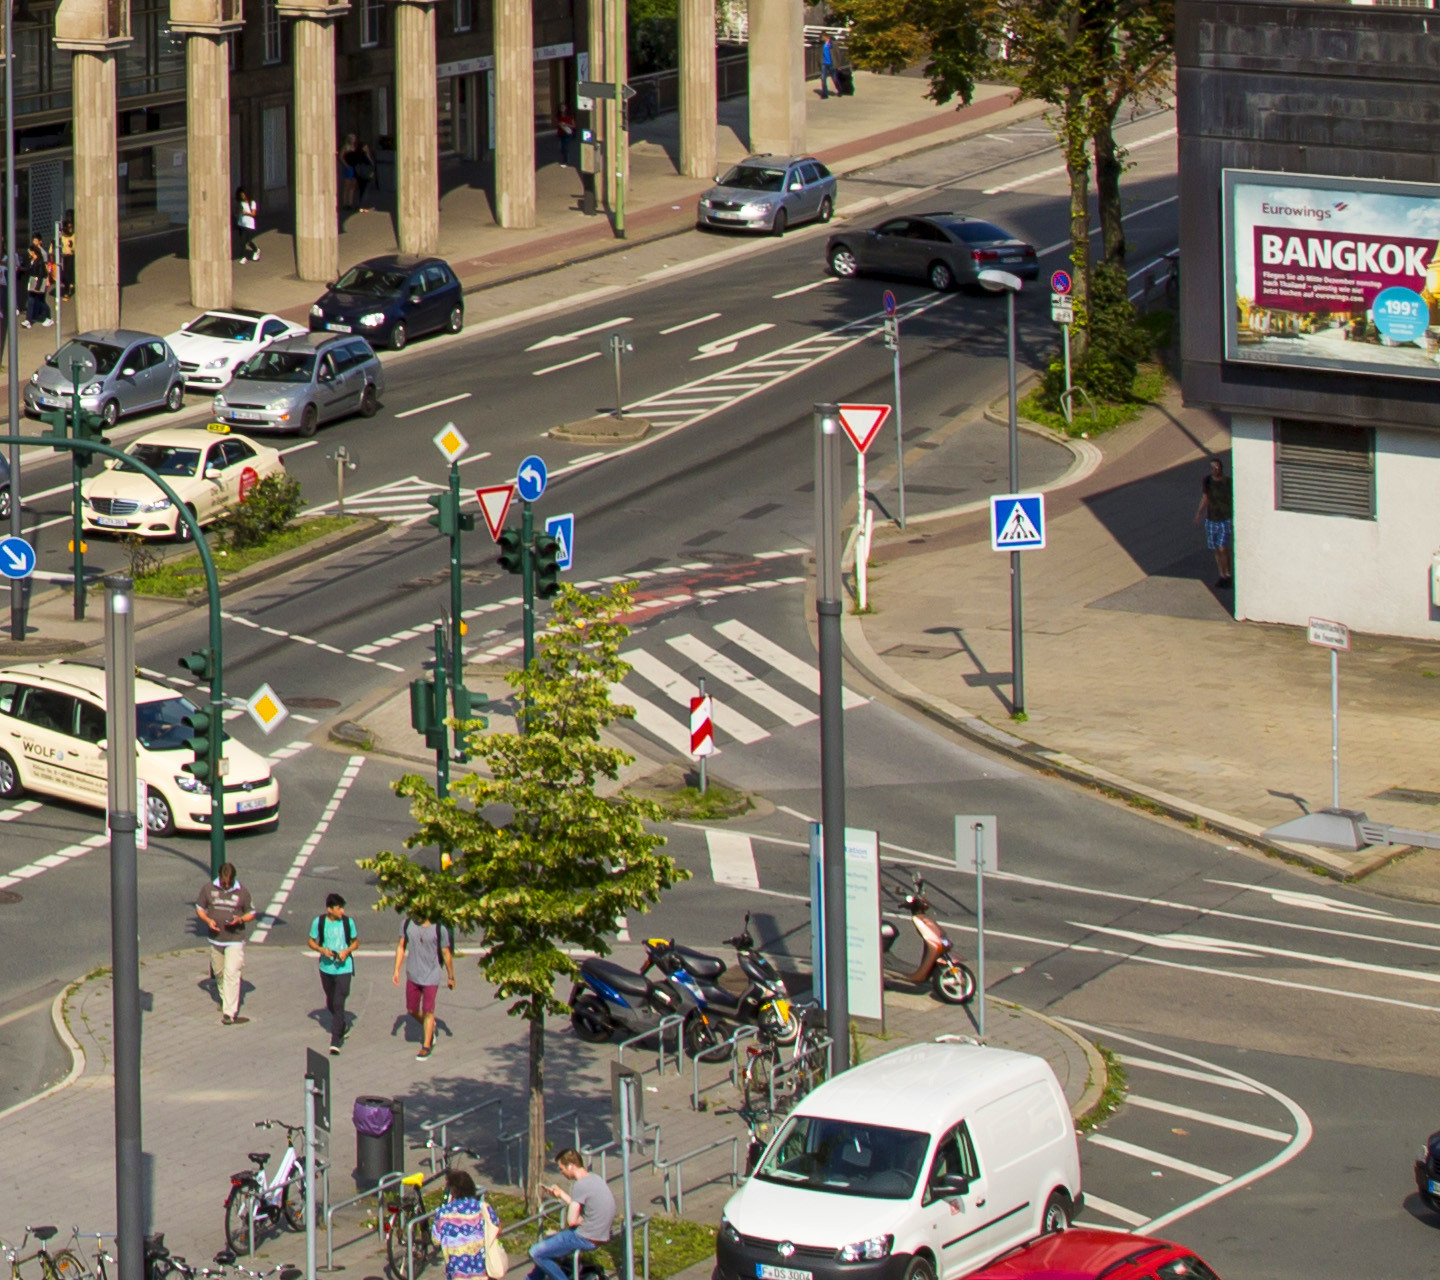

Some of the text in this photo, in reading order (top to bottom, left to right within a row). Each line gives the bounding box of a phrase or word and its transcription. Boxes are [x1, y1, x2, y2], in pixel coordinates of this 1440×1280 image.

[1262, 202, 1332, 221] Eurowings
[1261, 233, 1429, 277] BANGKOK
[1385, 299, 1411, 316] 199
[22, 740, 56, 758] WOLF
